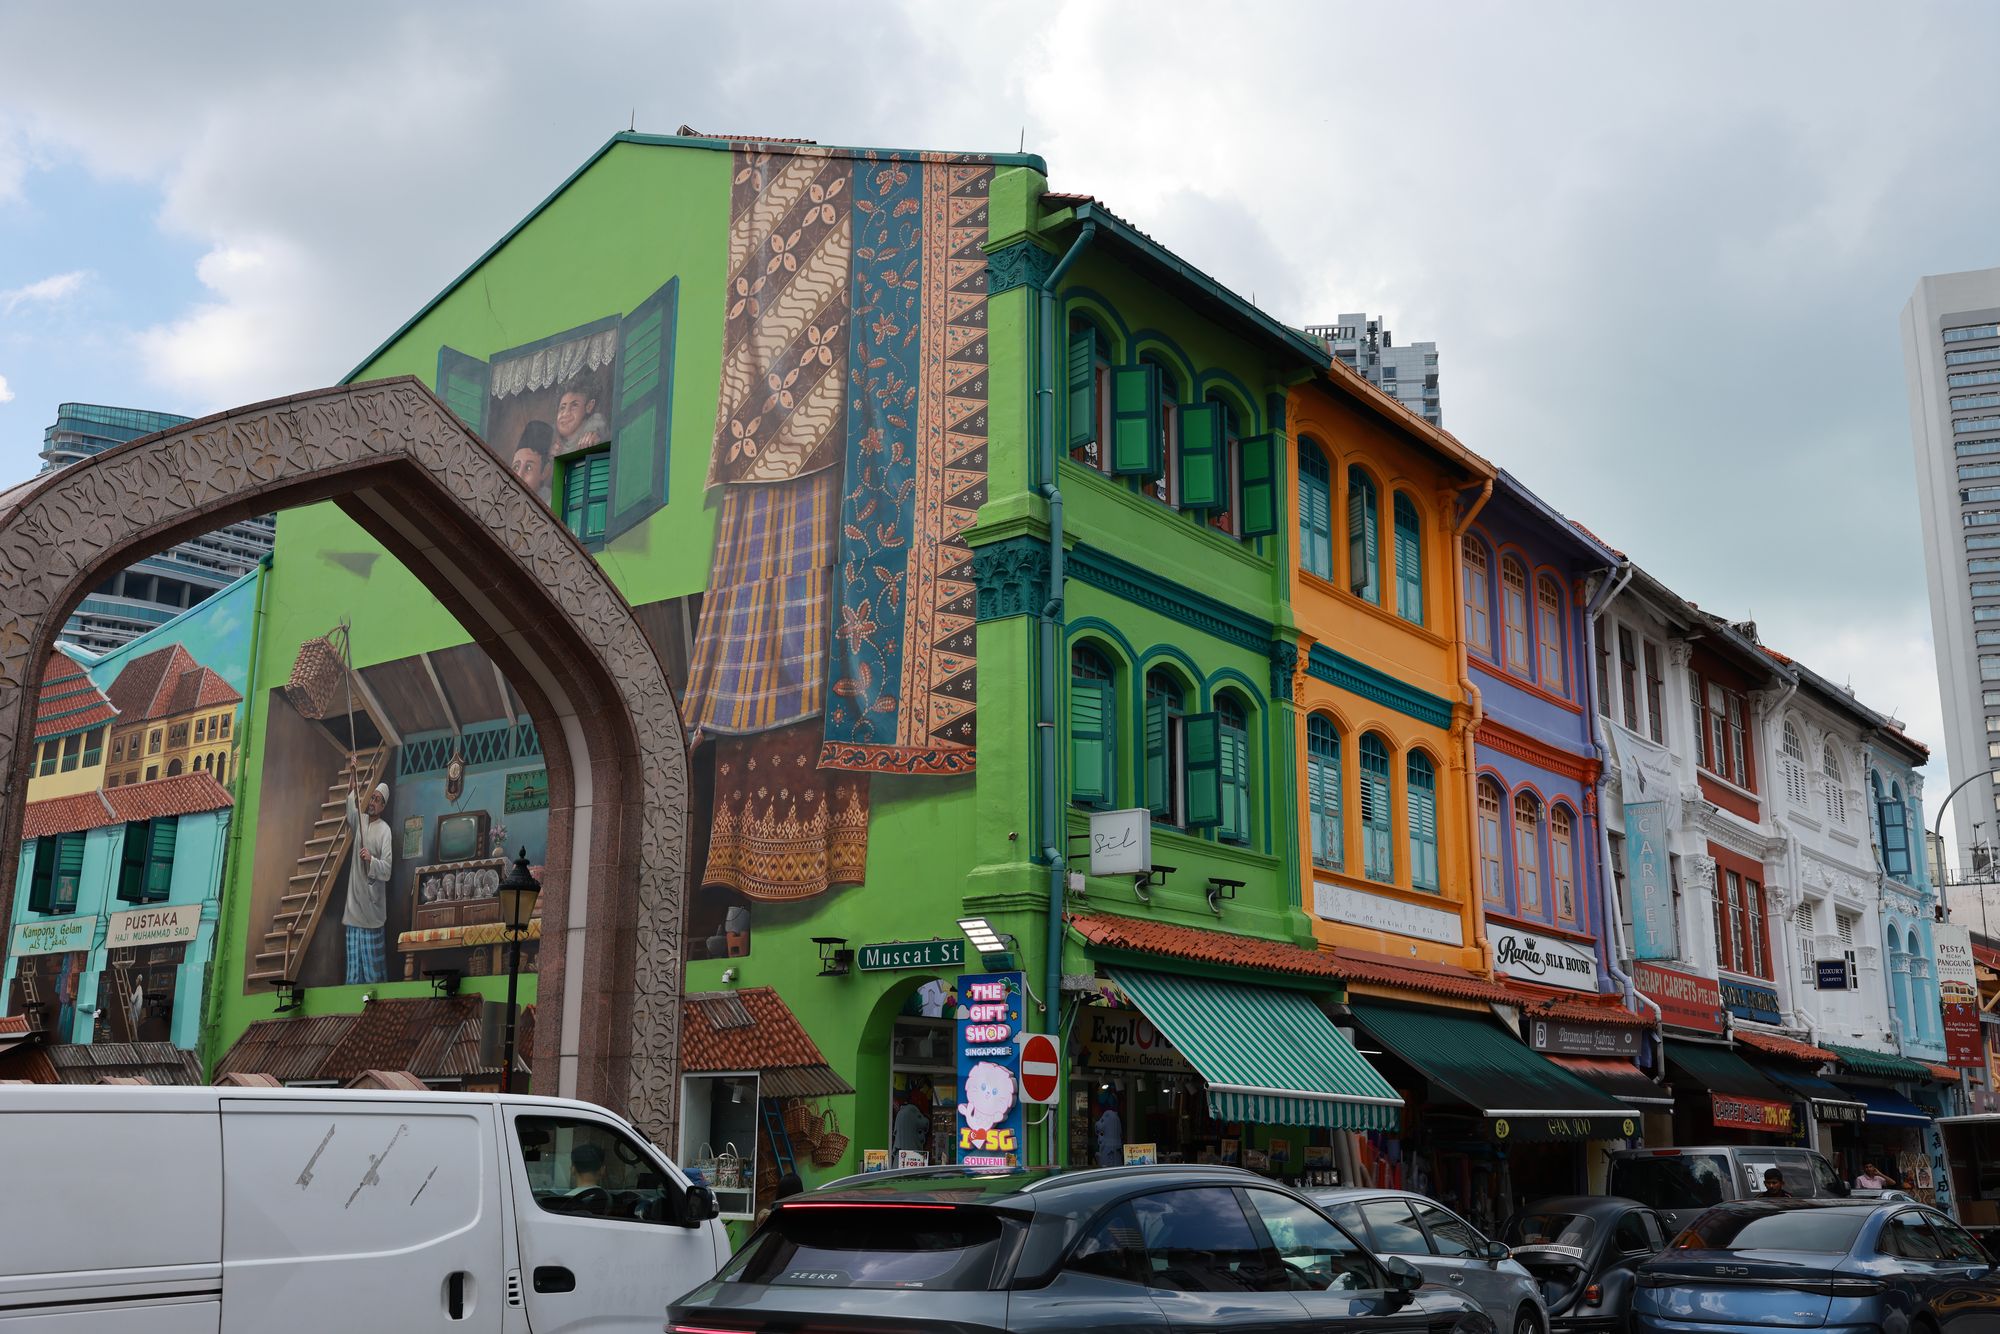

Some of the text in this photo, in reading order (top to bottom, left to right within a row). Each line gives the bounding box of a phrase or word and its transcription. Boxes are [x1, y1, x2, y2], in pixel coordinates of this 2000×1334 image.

[1638, 819, 1657, 945] CARPET
[125, 912, 178, 931] PUSTAKA
[22, 923, 82, 939] Kampong Gelam
[115, 926, 189, 942] HAJI MUHAMMAD SAID
[866, 944, 959, 966] Muscat St
[1497, 936, 1591, 974] Rania SILK HOUSE
[1939, 944, 1966, 954] PESTA
[1937, 958, 1972, 967] PANGGUNG
[971, 984, 1003, 1001] THE
[1634, 967, 1663, 995] SERAPI
[1664, 974, 1697, 1003] CARPETS
[1698, 988, 1708, 1004] PTE
[1708, 991, 1719, 1007] LTD
[970, 1004, 1007, 1022] GIFT
[965, 1024, 1009, 1043] SHOP
[1558, 1026, 1616, 1047] Paramount Fabrics
[965, 1047, 1008, 1056] SINGAPORE
[1098, 1051, 1130, 1064] Souvenir
[1139, 1053, 1173, 1067] Chocolate
[1714, 1100, 1791, 1126] CARPET SALE 70% OFF
[960, 1128, 1014, 1150] I SG
[790, 1272, 838, 1280] ZEEKR
[1715, 1266, 1749, 1275] BYD
